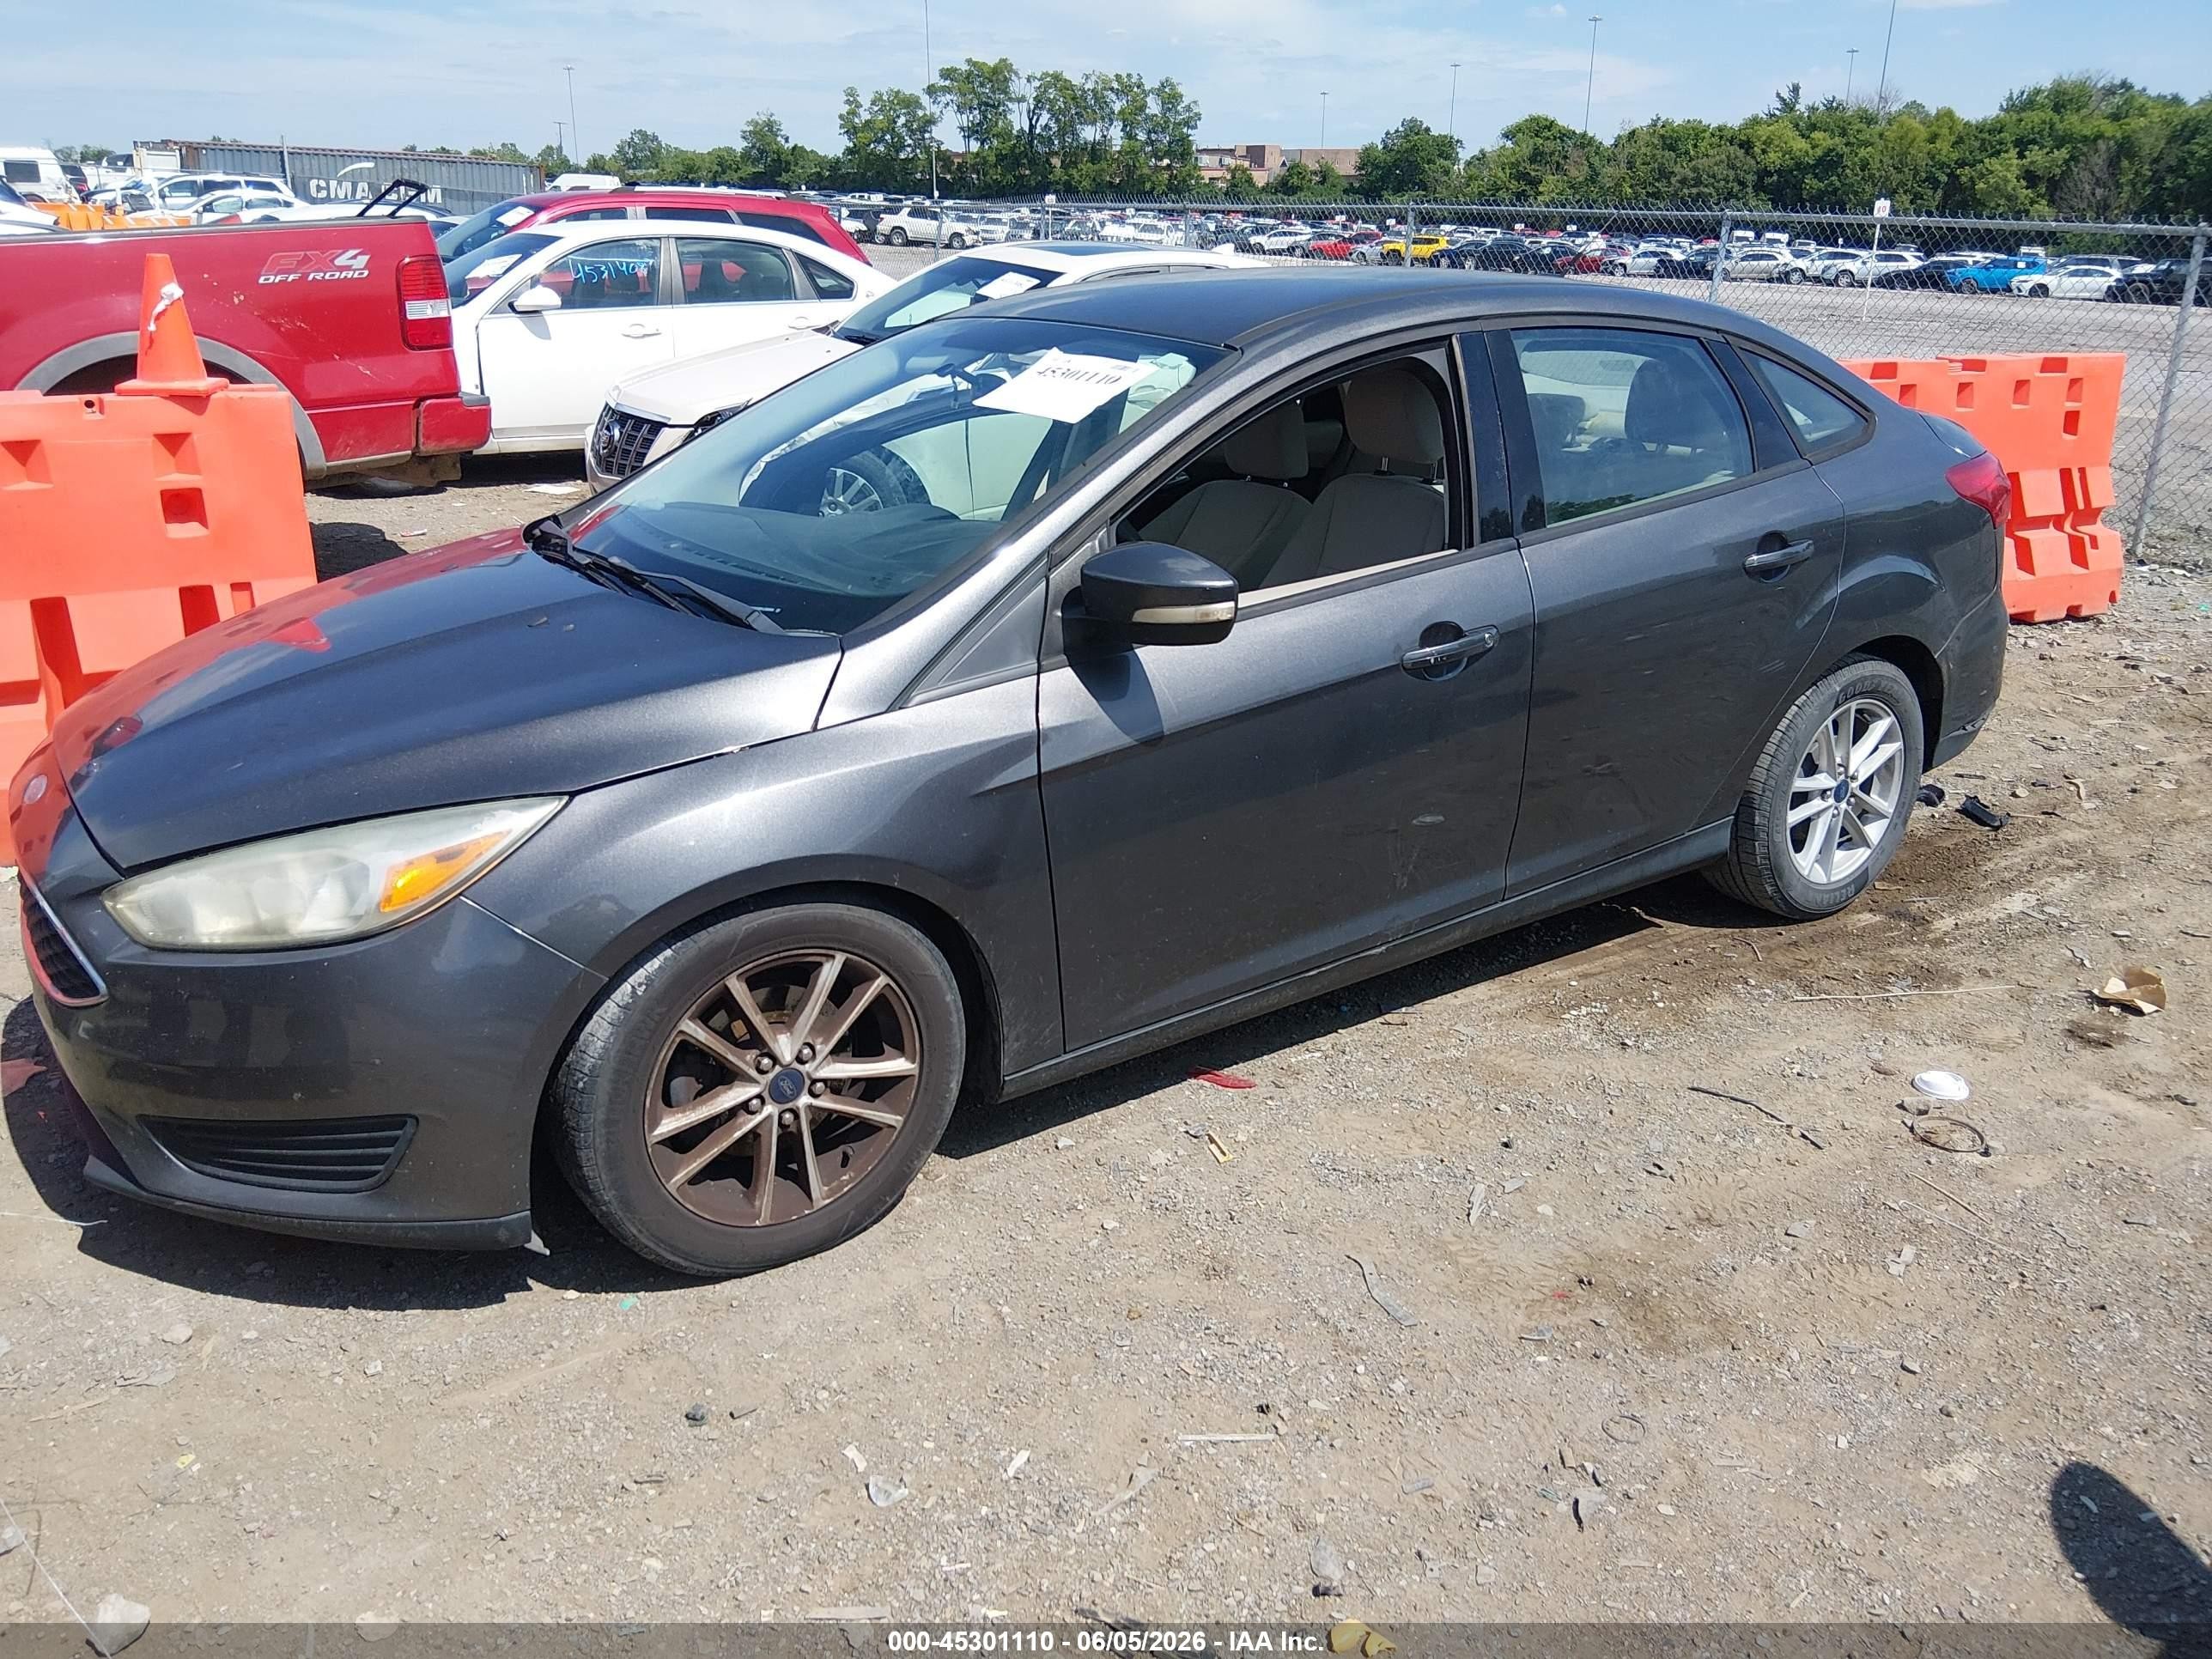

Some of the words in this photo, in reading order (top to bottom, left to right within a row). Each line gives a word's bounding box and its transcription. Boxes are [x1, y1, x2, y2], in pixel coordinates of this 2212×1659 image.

[310, 179, 373, 199] CMA
[261, 248, 371, 274] FX4
[258, 274, 293, 284] OFF
[307, 270, 369, 282] ROAD
